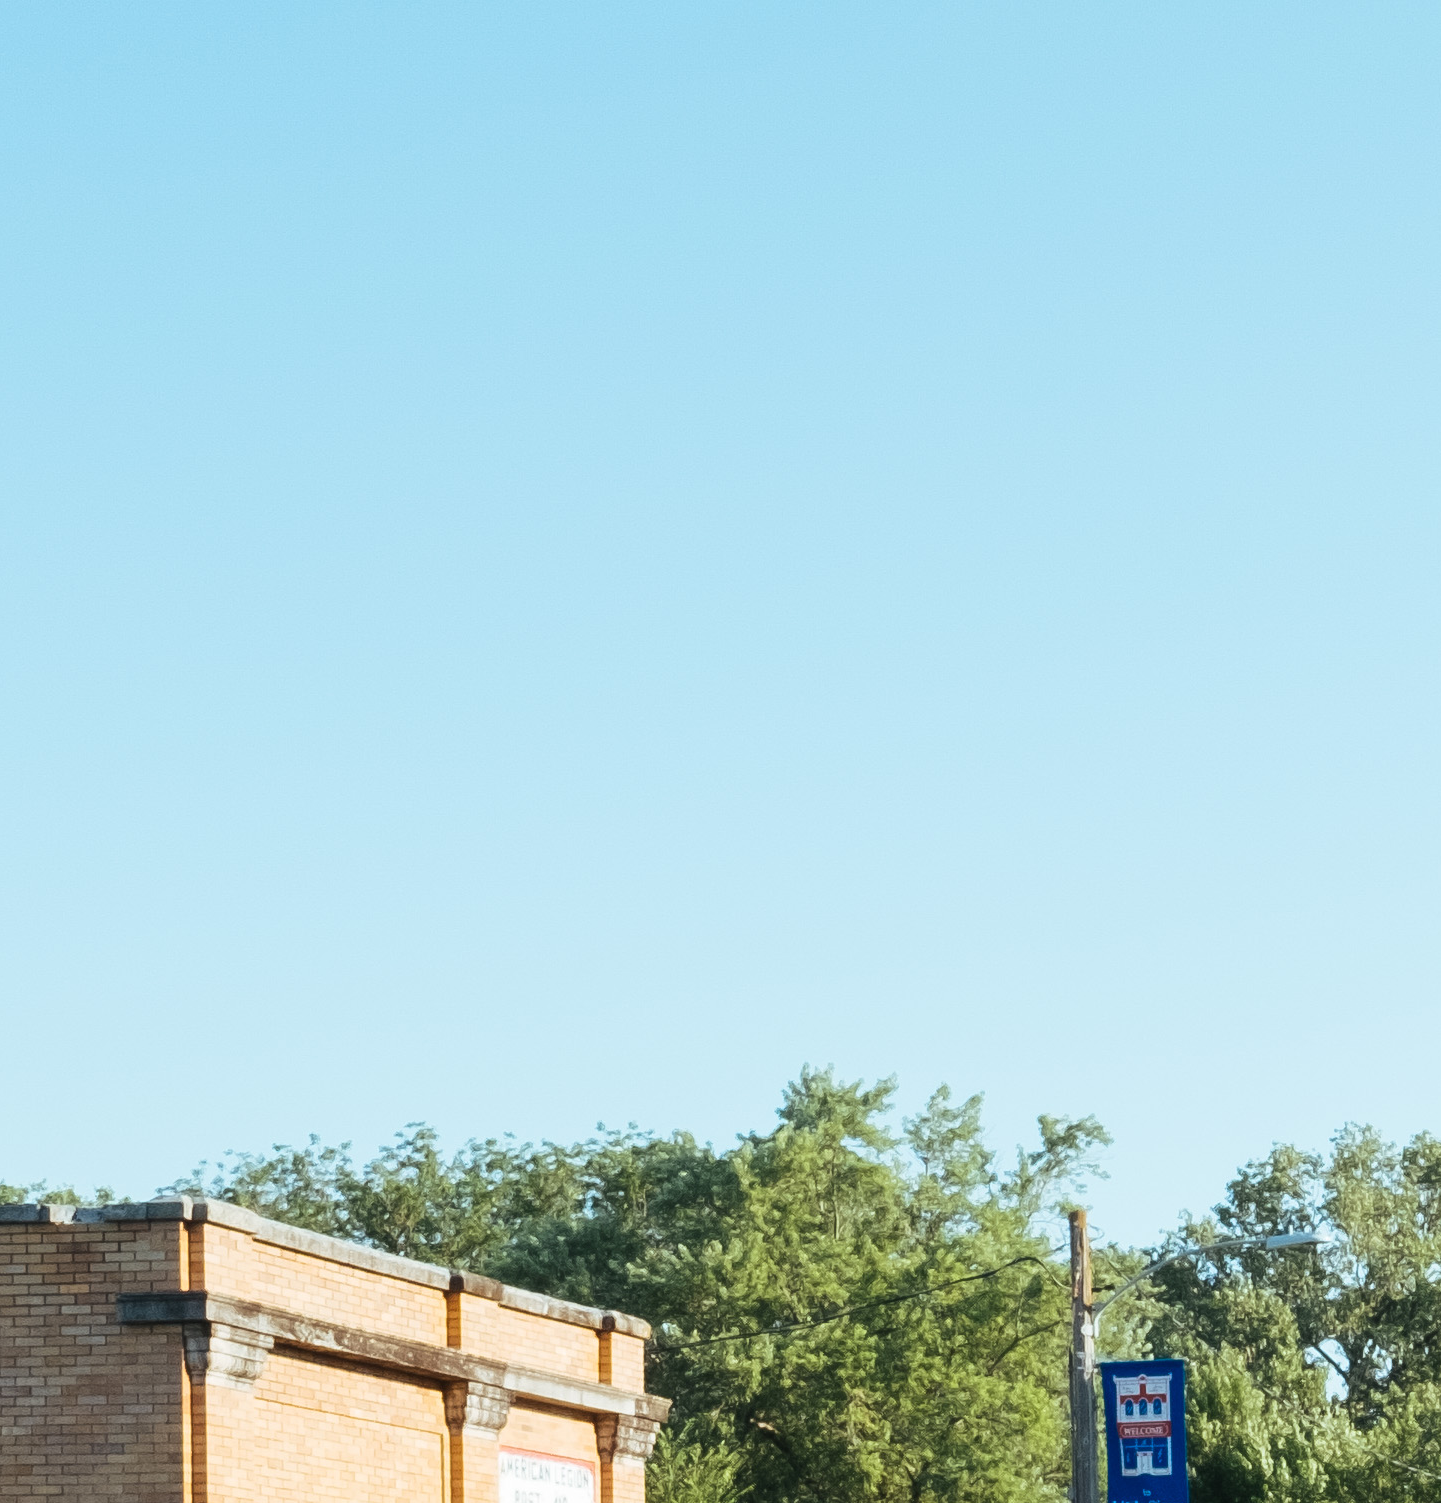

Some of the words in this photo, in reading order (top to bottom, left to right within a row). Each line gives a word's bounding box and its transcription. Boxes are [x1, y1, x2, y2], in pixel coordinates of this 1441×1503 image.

[1123, 1426, 1164, 1436] WELCOME
[500, 1457, 551, 1482] AMERICAN
[555, 1466, 589, 1489] LEGION
[1142, 1488, 1151, 1497] to
